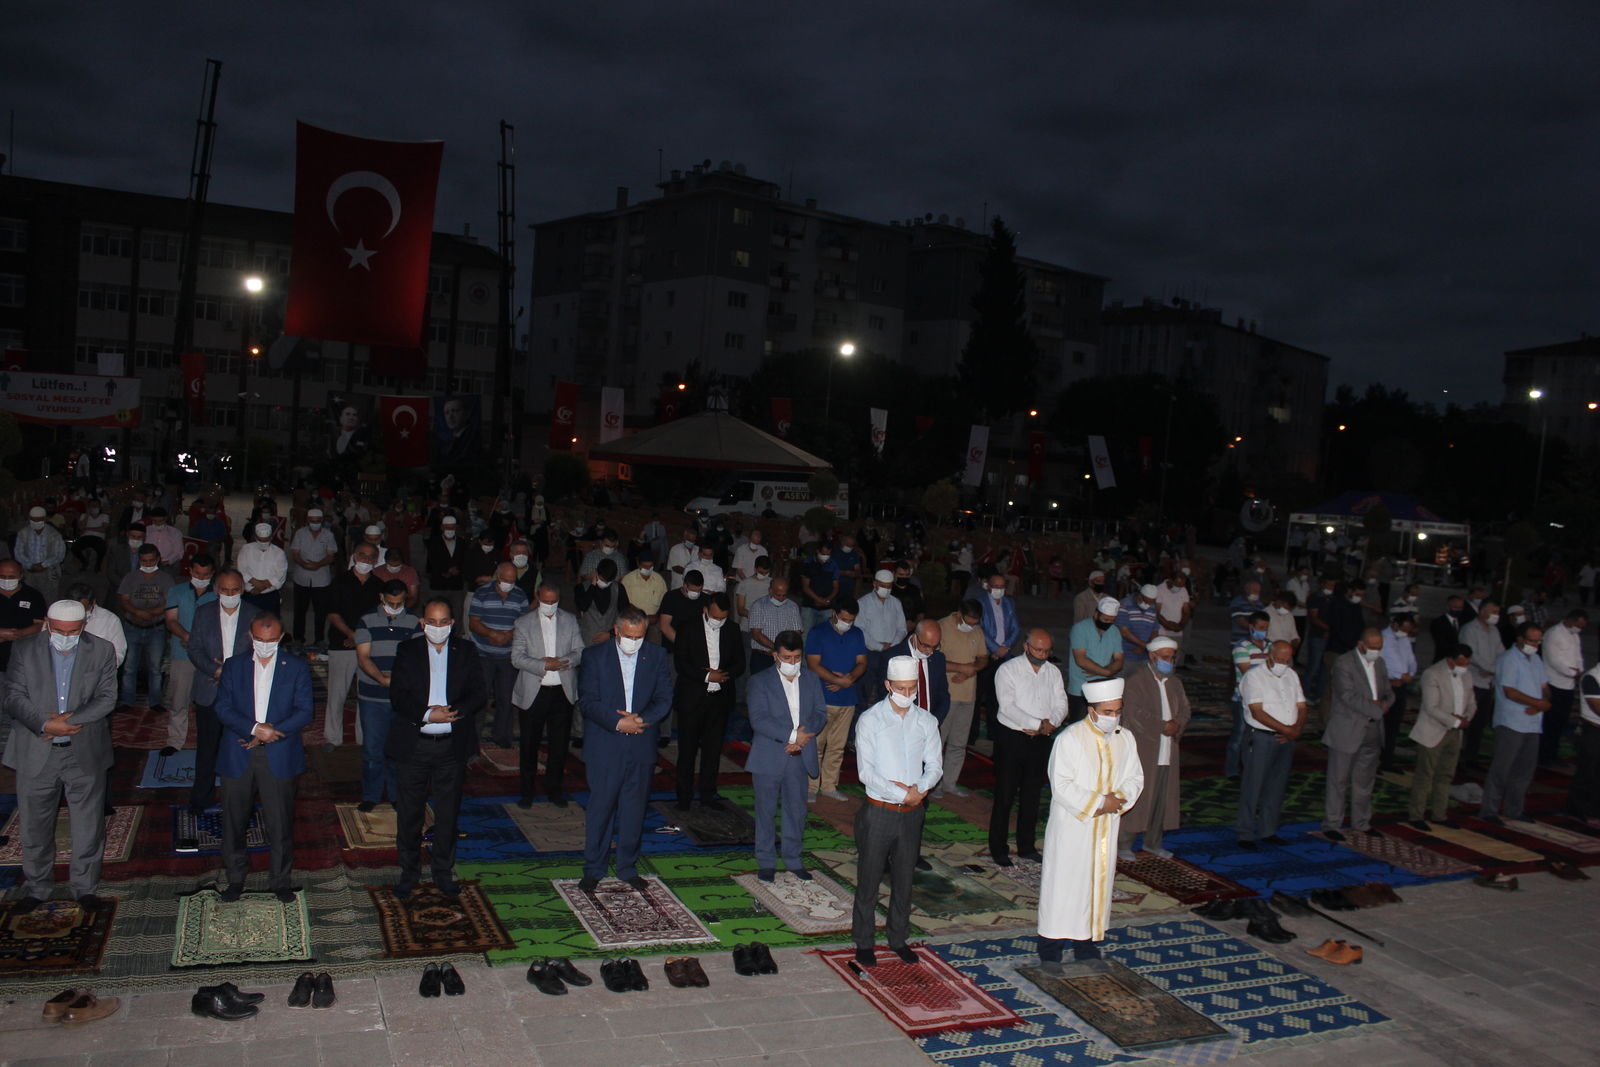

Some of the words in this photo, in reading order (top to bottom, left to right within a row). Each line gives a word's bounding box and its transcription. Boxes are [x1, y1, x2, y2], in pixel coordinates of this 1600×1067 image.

[7, 392, 50, 402] SOSYAL
[52, 395, 112, 405] MESAFEYE
[37, 404, 81, 414] UYUNUZ
